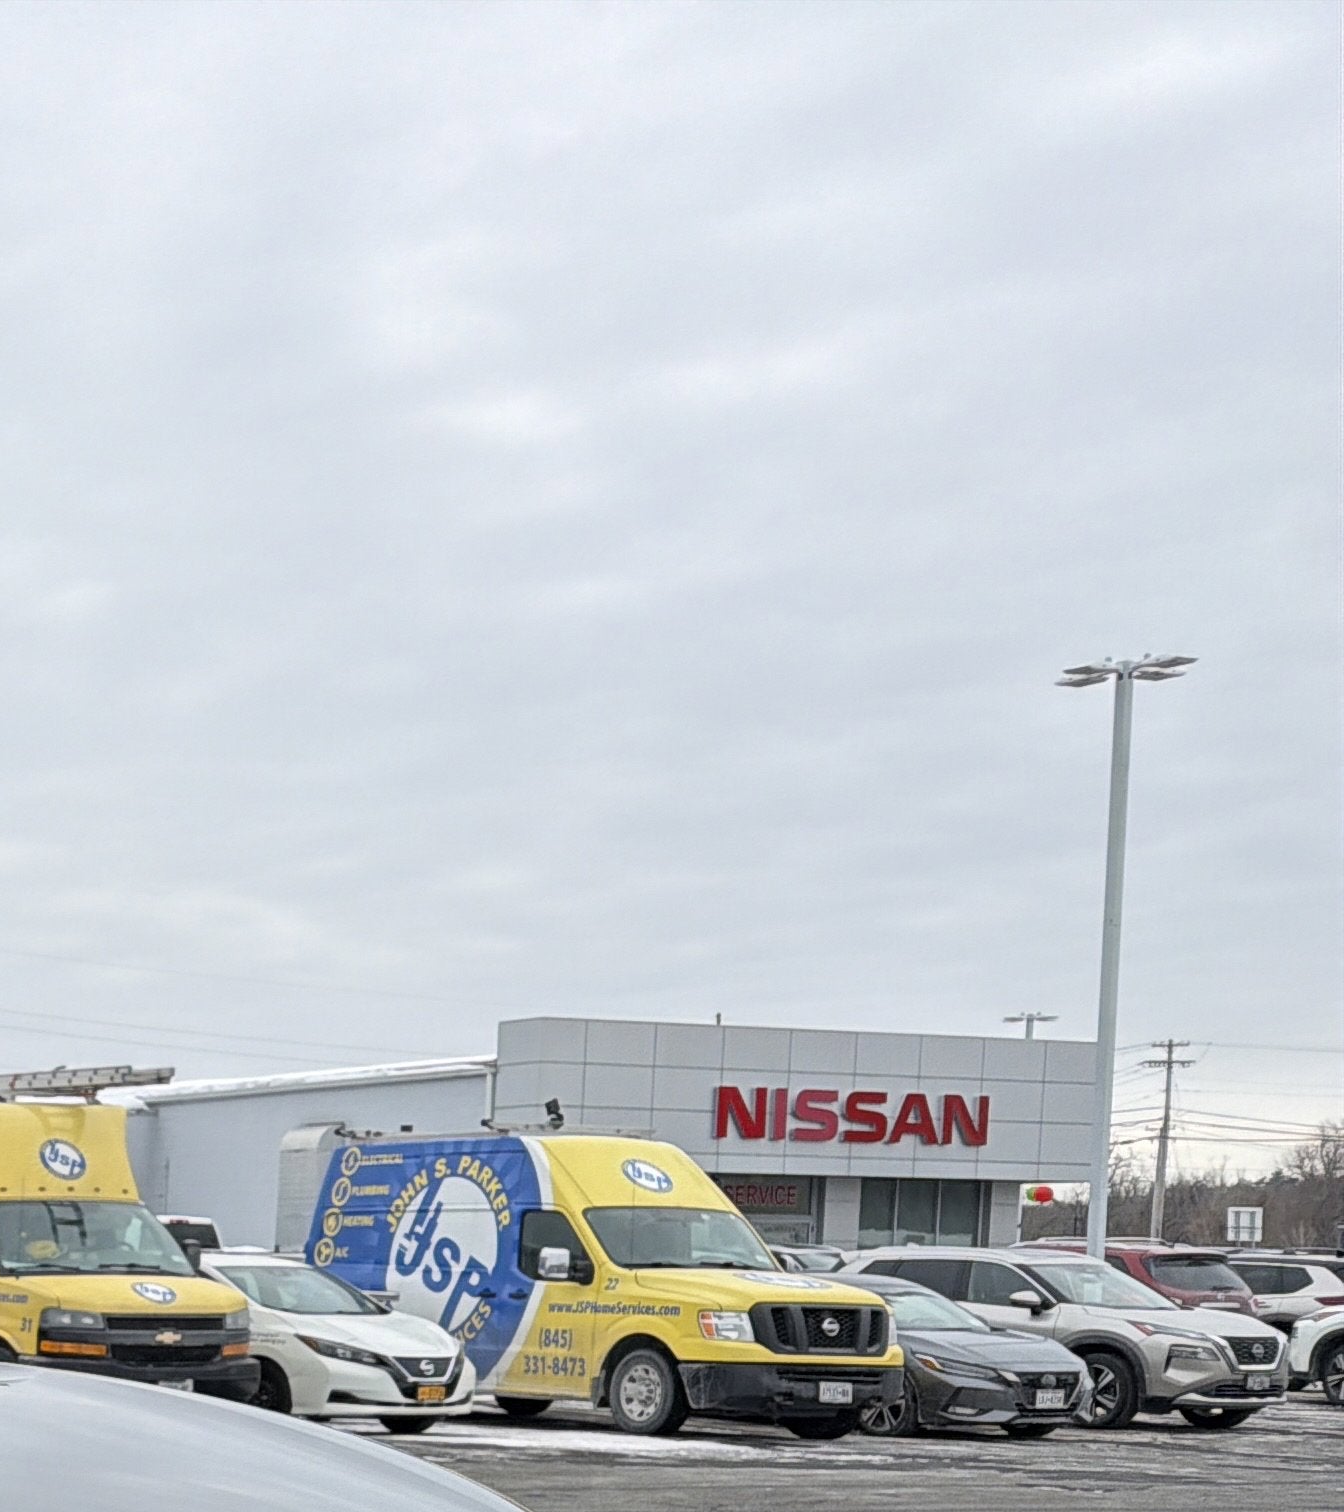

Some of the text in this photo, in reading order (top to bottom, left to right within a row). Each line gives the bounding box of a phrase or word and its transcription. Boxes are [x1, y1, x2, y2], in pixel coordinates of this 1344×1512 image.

[714, 1085, 991, 1146] NISSAN
[387, 1155, 511, 1234] JOHN S. PARKER
[724, 1184, 796, 1205] SERVICE
[395, 1178, 494, 1332] JSP
[455, 1300, 492, 1345] ICES
[548, 1301, 681, 1317] www.JSPHomeServices.com
[538, 1327, 573, 1351] (845)
[523, 1355, 586, 1378] 331-8473
